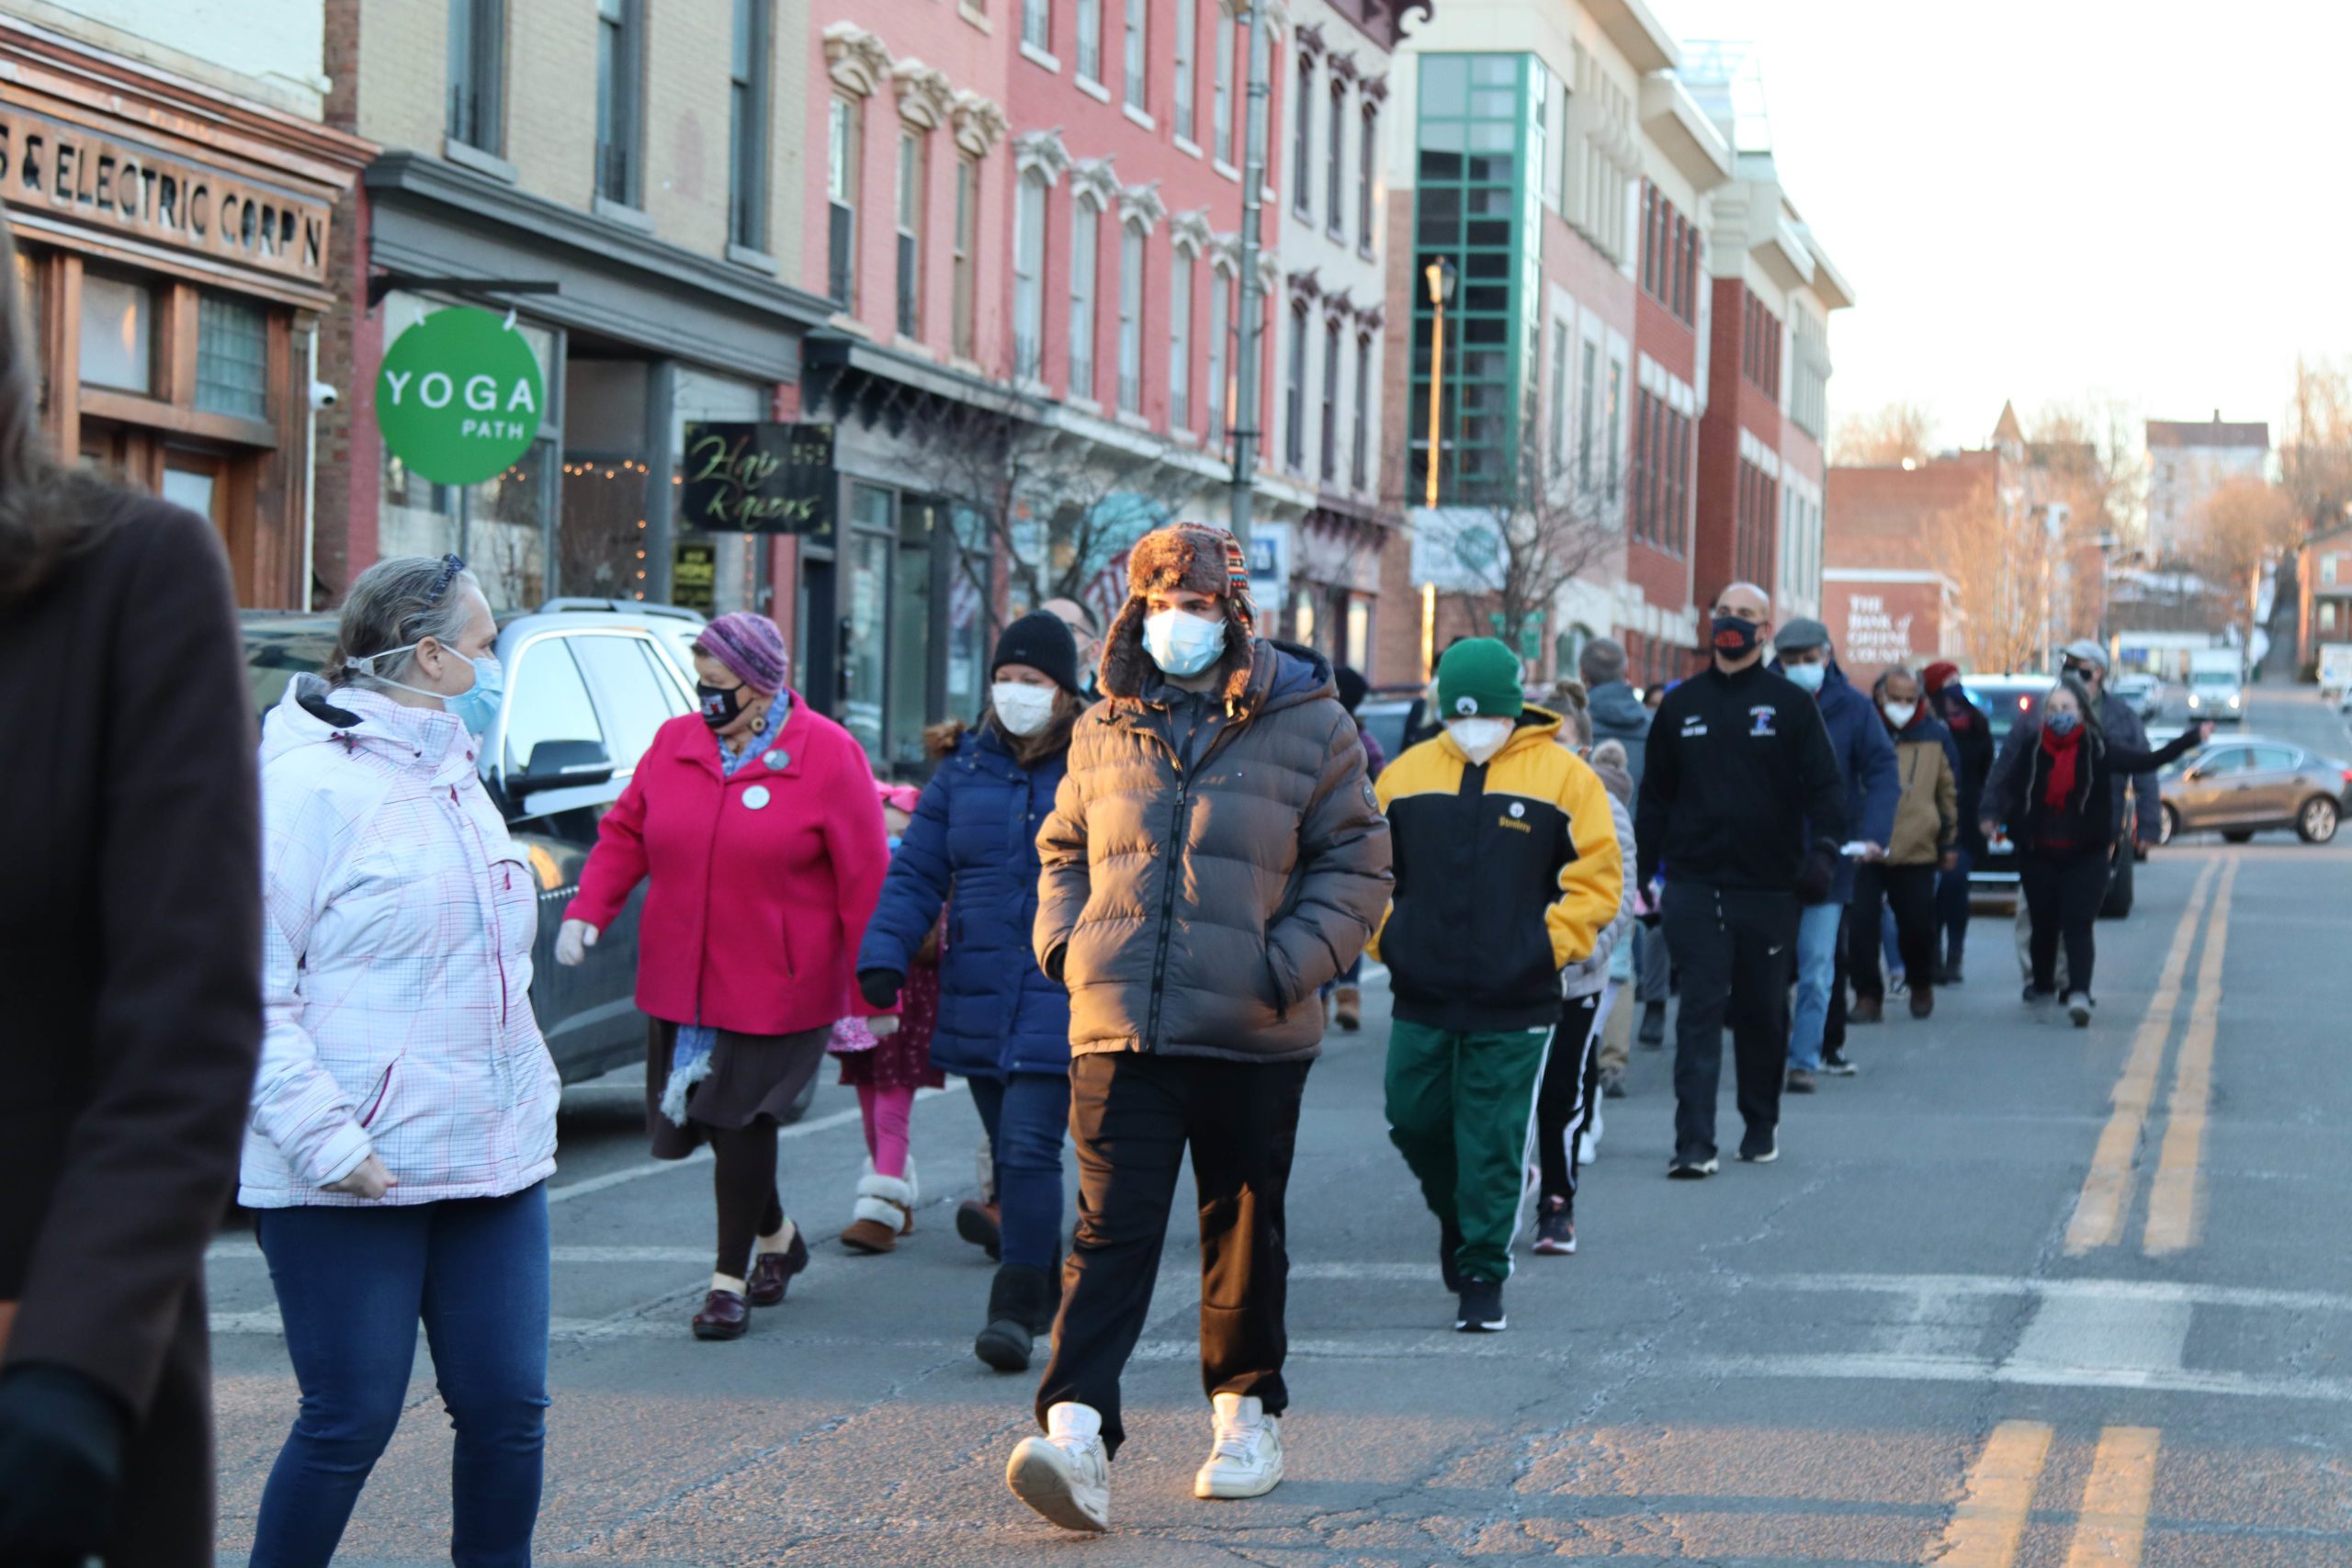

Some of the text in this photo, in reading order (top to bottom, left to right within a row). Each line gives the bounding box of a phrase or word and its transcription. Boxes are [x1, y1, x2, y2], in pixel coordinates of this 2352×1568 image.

[21, 134, 43, 190] &
[55, 142, 209, 236] ELECTRIC
[220, 194, 322, 267] CORP'N
[385, 369, 536, 413] YOGA
[461, 419, 525, 440] PATH
[689, 434, 787, 491] Hair
[1849, 593, 1883, 613] THE
[1848, 613, 1893, 630] BANK
